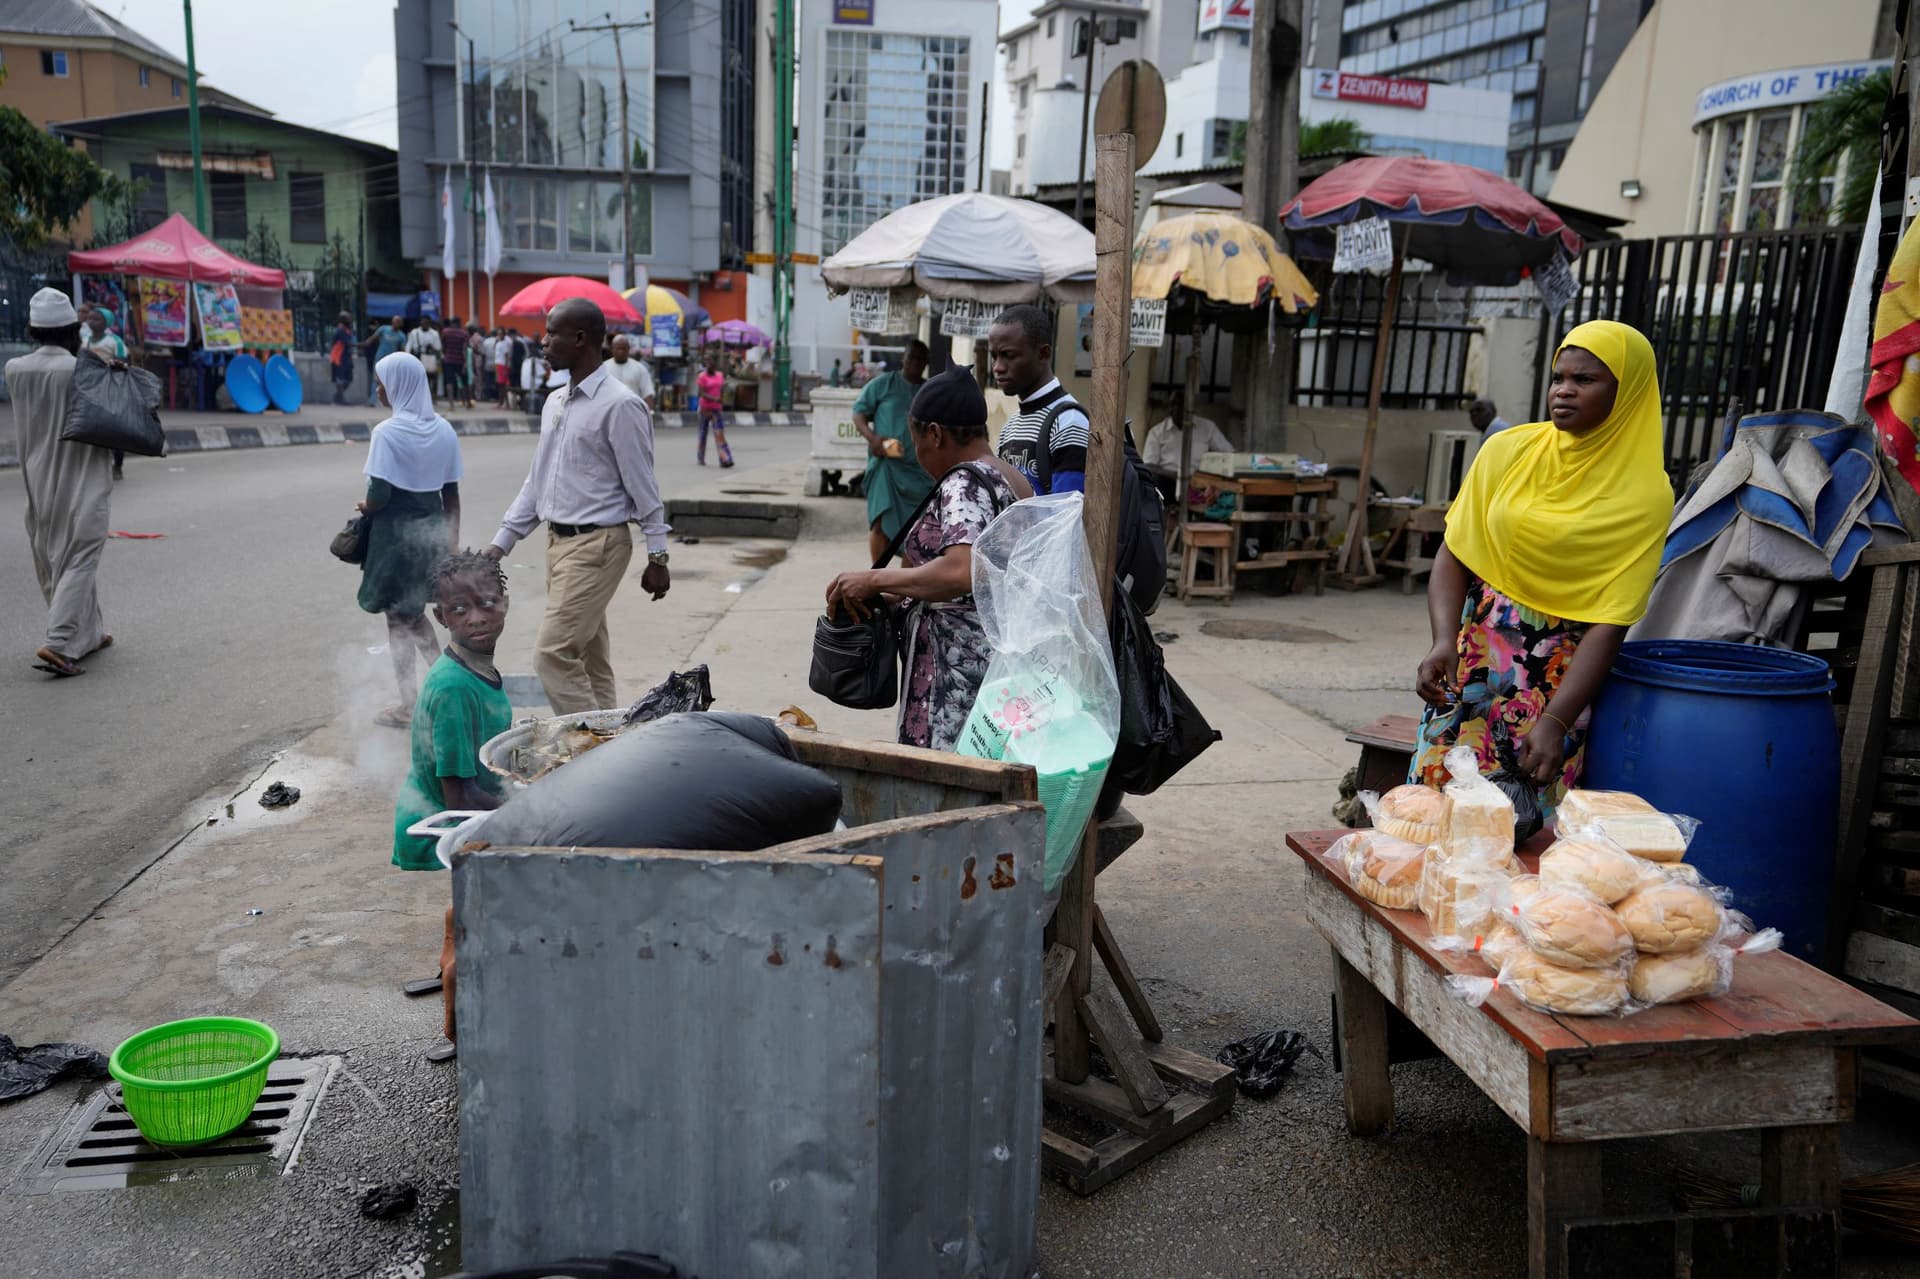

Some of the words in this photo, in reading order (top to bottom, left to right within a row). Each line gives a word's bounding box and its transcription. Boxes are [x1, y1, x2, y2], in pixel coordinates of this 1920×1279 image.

[1341, 77, 1387, 98] ZENITH
[1388, 81, 1425, 105] BANK
[1704, 81, 1761, 110] CHURCH
[1770, 76, 1799, 96] OF
[1140, 299, 1165, 311] YOUR
[1131, 312, 1164, 330] DAVIT
[982, 713, 1004, 738] HAPPY
